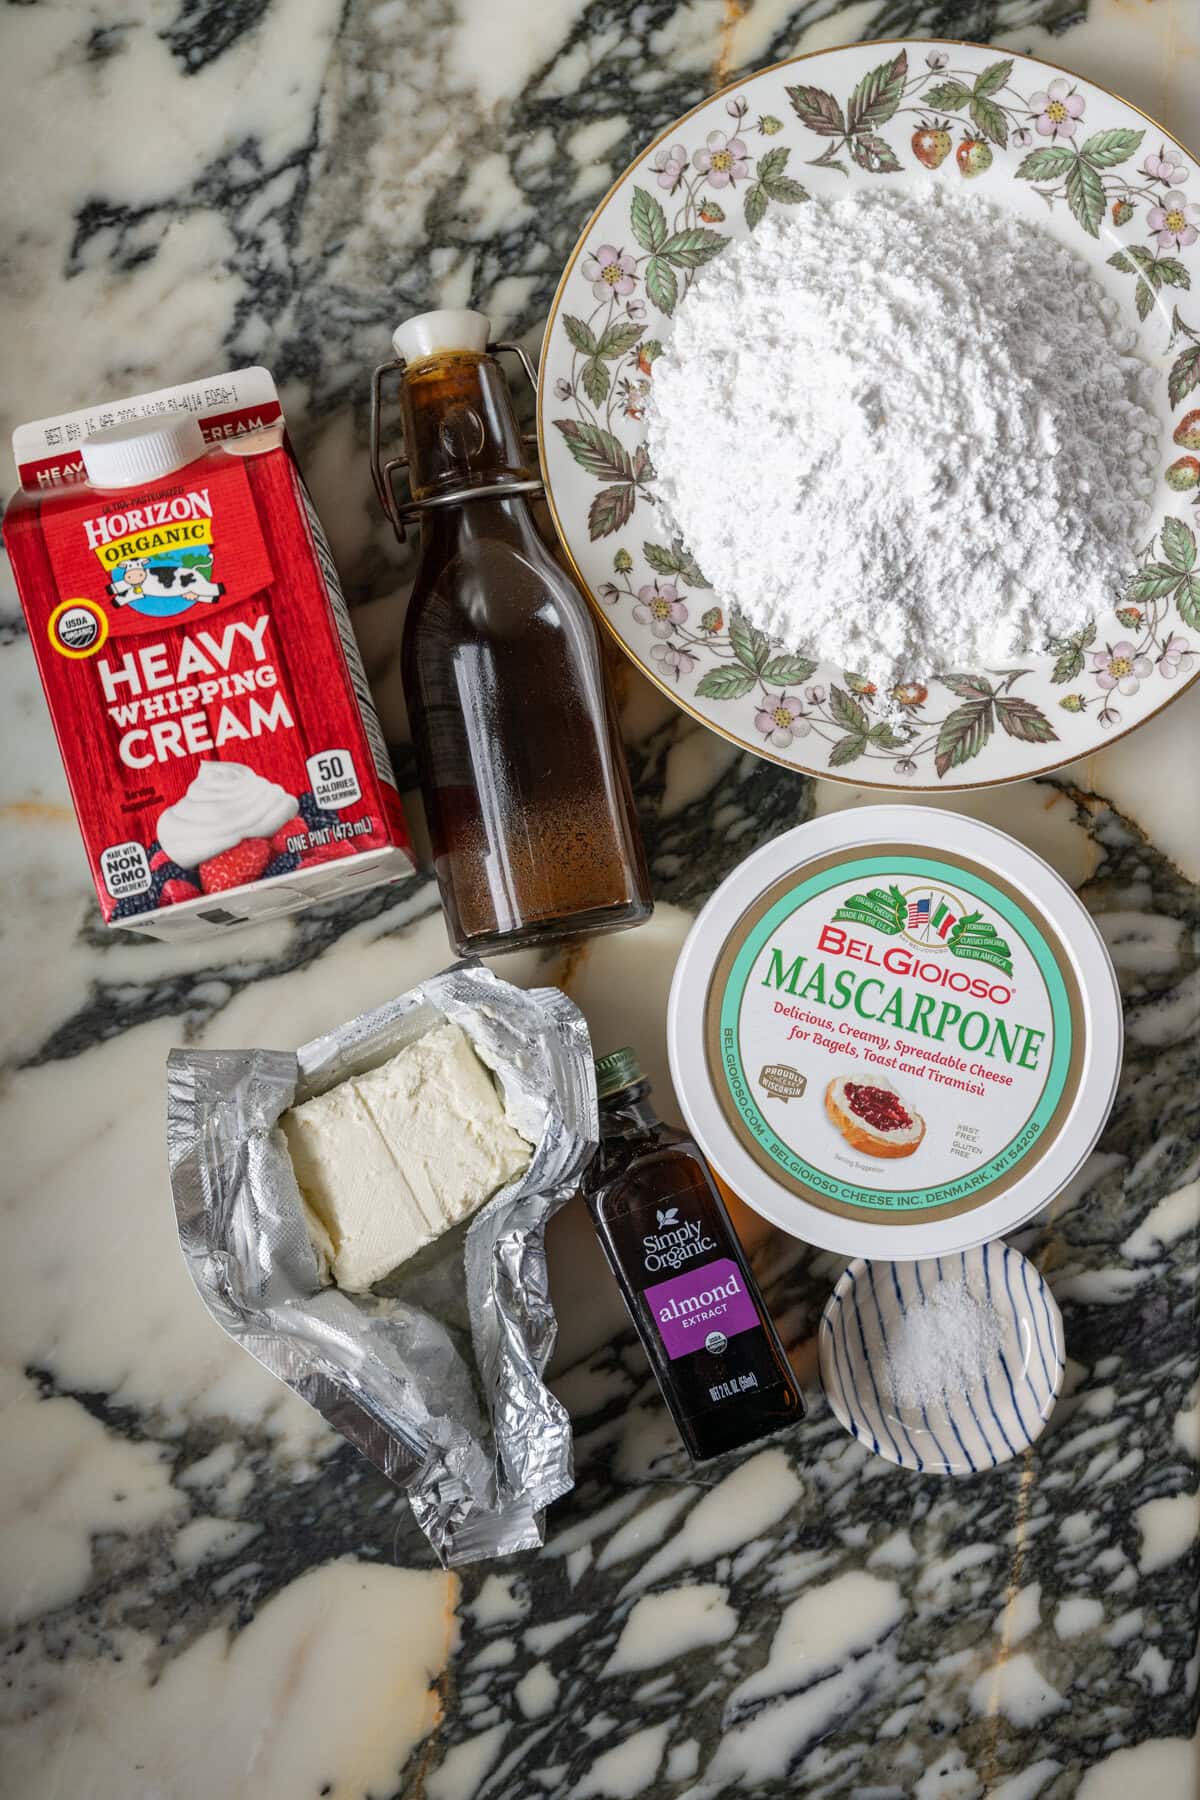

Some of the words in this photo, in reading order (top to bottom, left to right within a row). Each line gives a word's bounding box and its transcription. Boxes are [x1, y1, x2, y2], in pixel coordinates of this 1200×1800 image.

[36, 460, 83, 482] HEAV
[83, 489, 213, 550] HORIZON
[105, 524, 205, 562] ORGANIC
[65, 616, 87, 629] USDA
[97, 615, 270, 703] HEAVY
[108, 665, 278, 728] WHIPPING
[118, 691, 295, 769] CREAM
[317, 756, 344, 781] 50
[316, 778, 356, 795] CALORIES
[319, 794, 331, 805] PER
[331, 789, 358, 801] SERVING
[107, 849, 122, 861] MADE
[122, 845, 137, 857] WITH
[287, 834, 308, 853] ONE
[308, 828, 332, 848] PINT
[106, 854, 143, 874] NON
[110, 867, 146, 886] GMO
[113, 880, 149, 895] INGREDIENTS
[979, 952, 1007, 968] AMERICA
[761, 948, 1045, 1071] MASCARPONE
[773, 1001, 835, 1033] Delicious,
[838, 1022, 891, 1050] Creamy,
[894, 1040, 967, 1072] Spreadable
[969, 1063, 1014, 1086] Cheese
[786, 1025, 811, 1041] for
[812, 1032, 859, 1058] Bagels,
[863, 1048, 898, 1069] Toast
[898, 1061, 926, 1078] and
[927, 1068, 985, 1096] Tiramisù
[762, 1076, 802, 1095] WISCONSIN
[765, 1067, 805, 1084] PROUDLY
[724, 1027, 766, 1136] BELGIOIOSO.COM
[769, 1143, 838, 1194] BELGIOIOSO
[841, 1188, 894, 1206] CHEESE
[896, 1195, 923, 1206] INC.
[991, 1157, 1010, 1173] WI
[1007, 1122, 1041, 1160] 54208
[952, 1140, 983, 1154] GLUTEN
[954, 1131, 977, 1143] FREE
[643, 1220, 701, 1254] Simply
[658, 1275, 741, 1323] almond
[682, 1303, 729, 1329] EXTRACT
